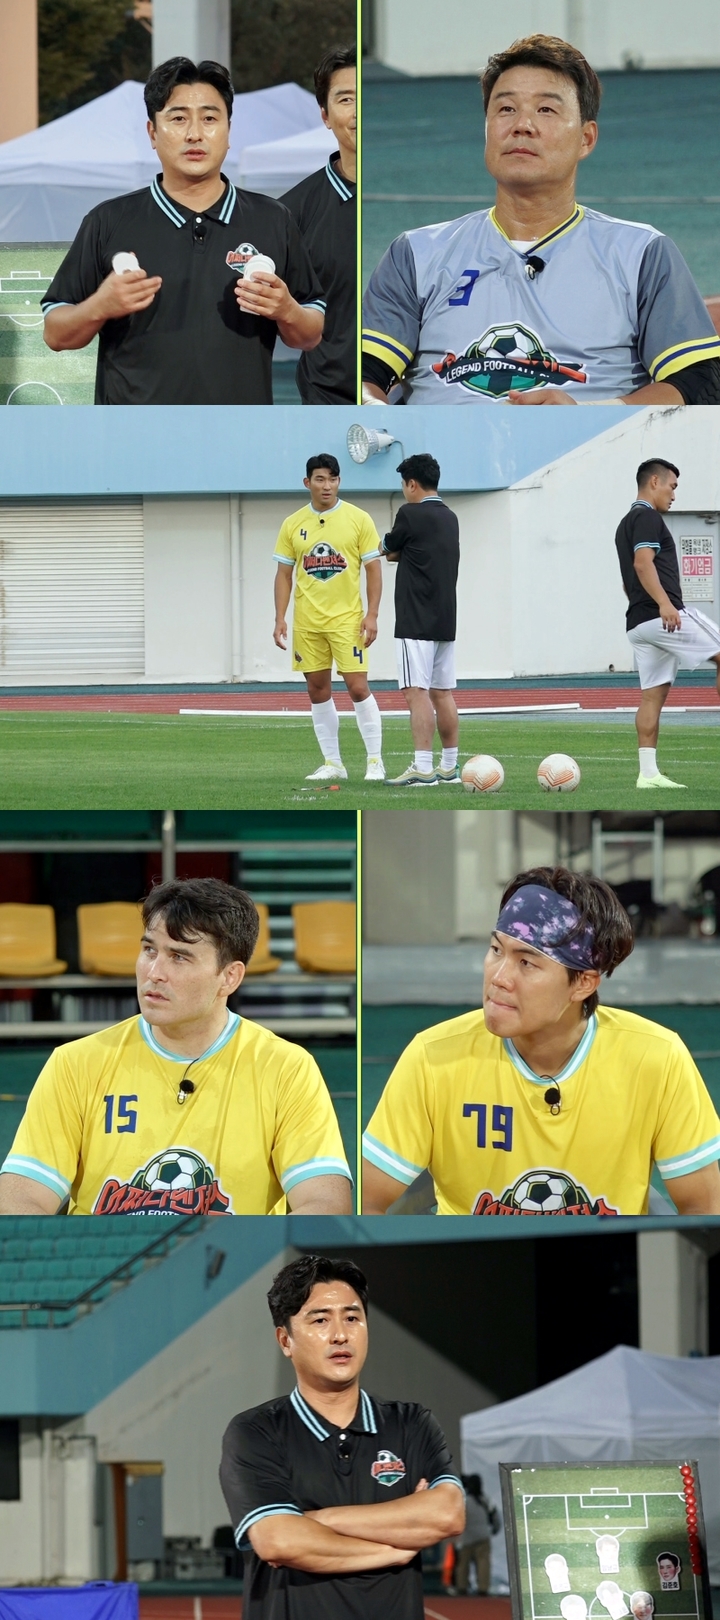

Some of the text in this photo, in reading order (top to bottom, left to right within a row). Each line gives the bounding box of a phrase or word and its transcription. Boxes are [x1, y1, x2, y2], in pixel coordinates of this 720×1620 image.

[449, 270, 480, 306] 3
[446, 361, 481, 382] LEGEND
[300, 528, 307, 540] 4
[684, 558, 711, 574] 화기엄금
[353, 646, 363, 664] 4
[104, 1094, 138, 1134] 15
[463, 1103, 513, 1152] 79
